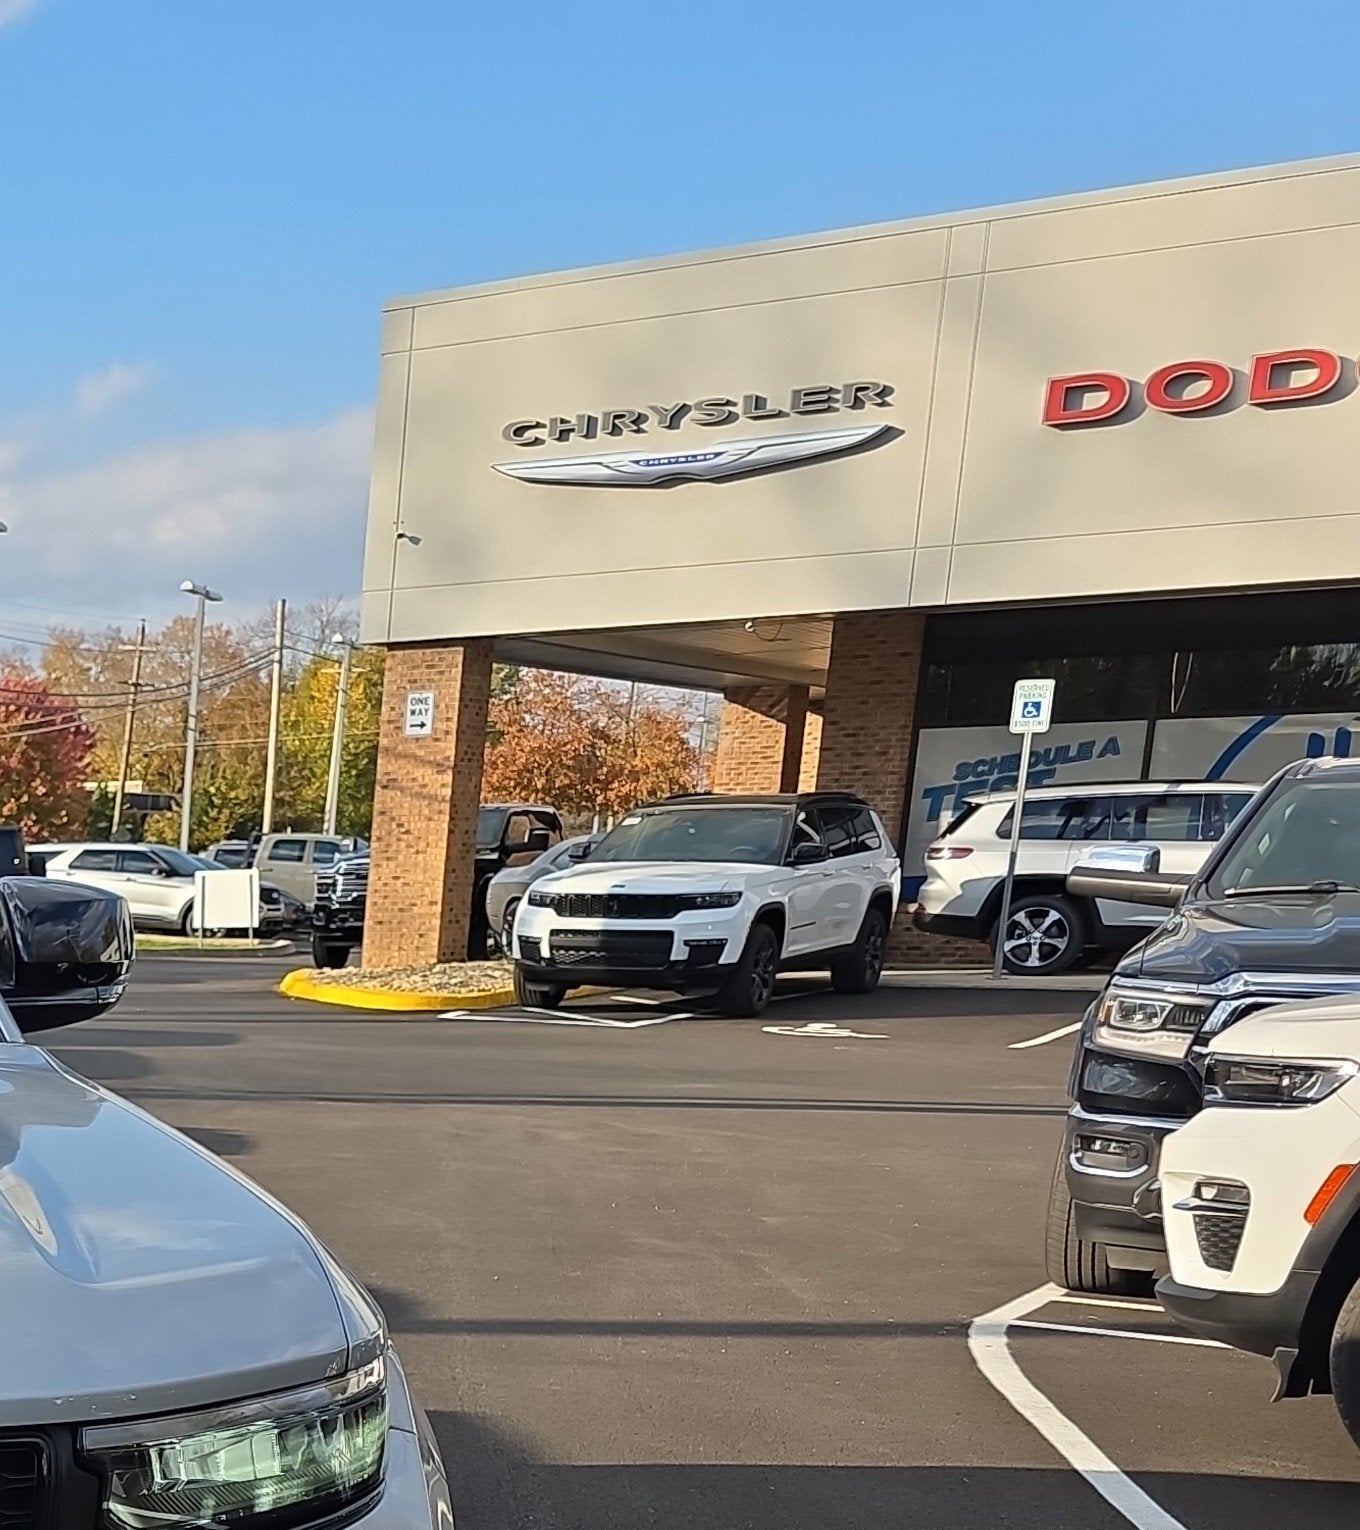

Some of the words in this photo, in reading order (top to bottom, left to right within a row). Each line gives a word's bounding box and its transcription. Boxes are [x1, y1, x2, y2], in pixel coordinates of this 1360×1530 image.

[1041, 348, 1360, 426] DOD
[501, 380, 895, 447] CHRYSLER
[409, 708, 430, 717] WAY
[410, 697, 430, 706] ONE
[952, 739, 1096, 781] SCHEDULE
[1096, 736, 1121, 758] A
